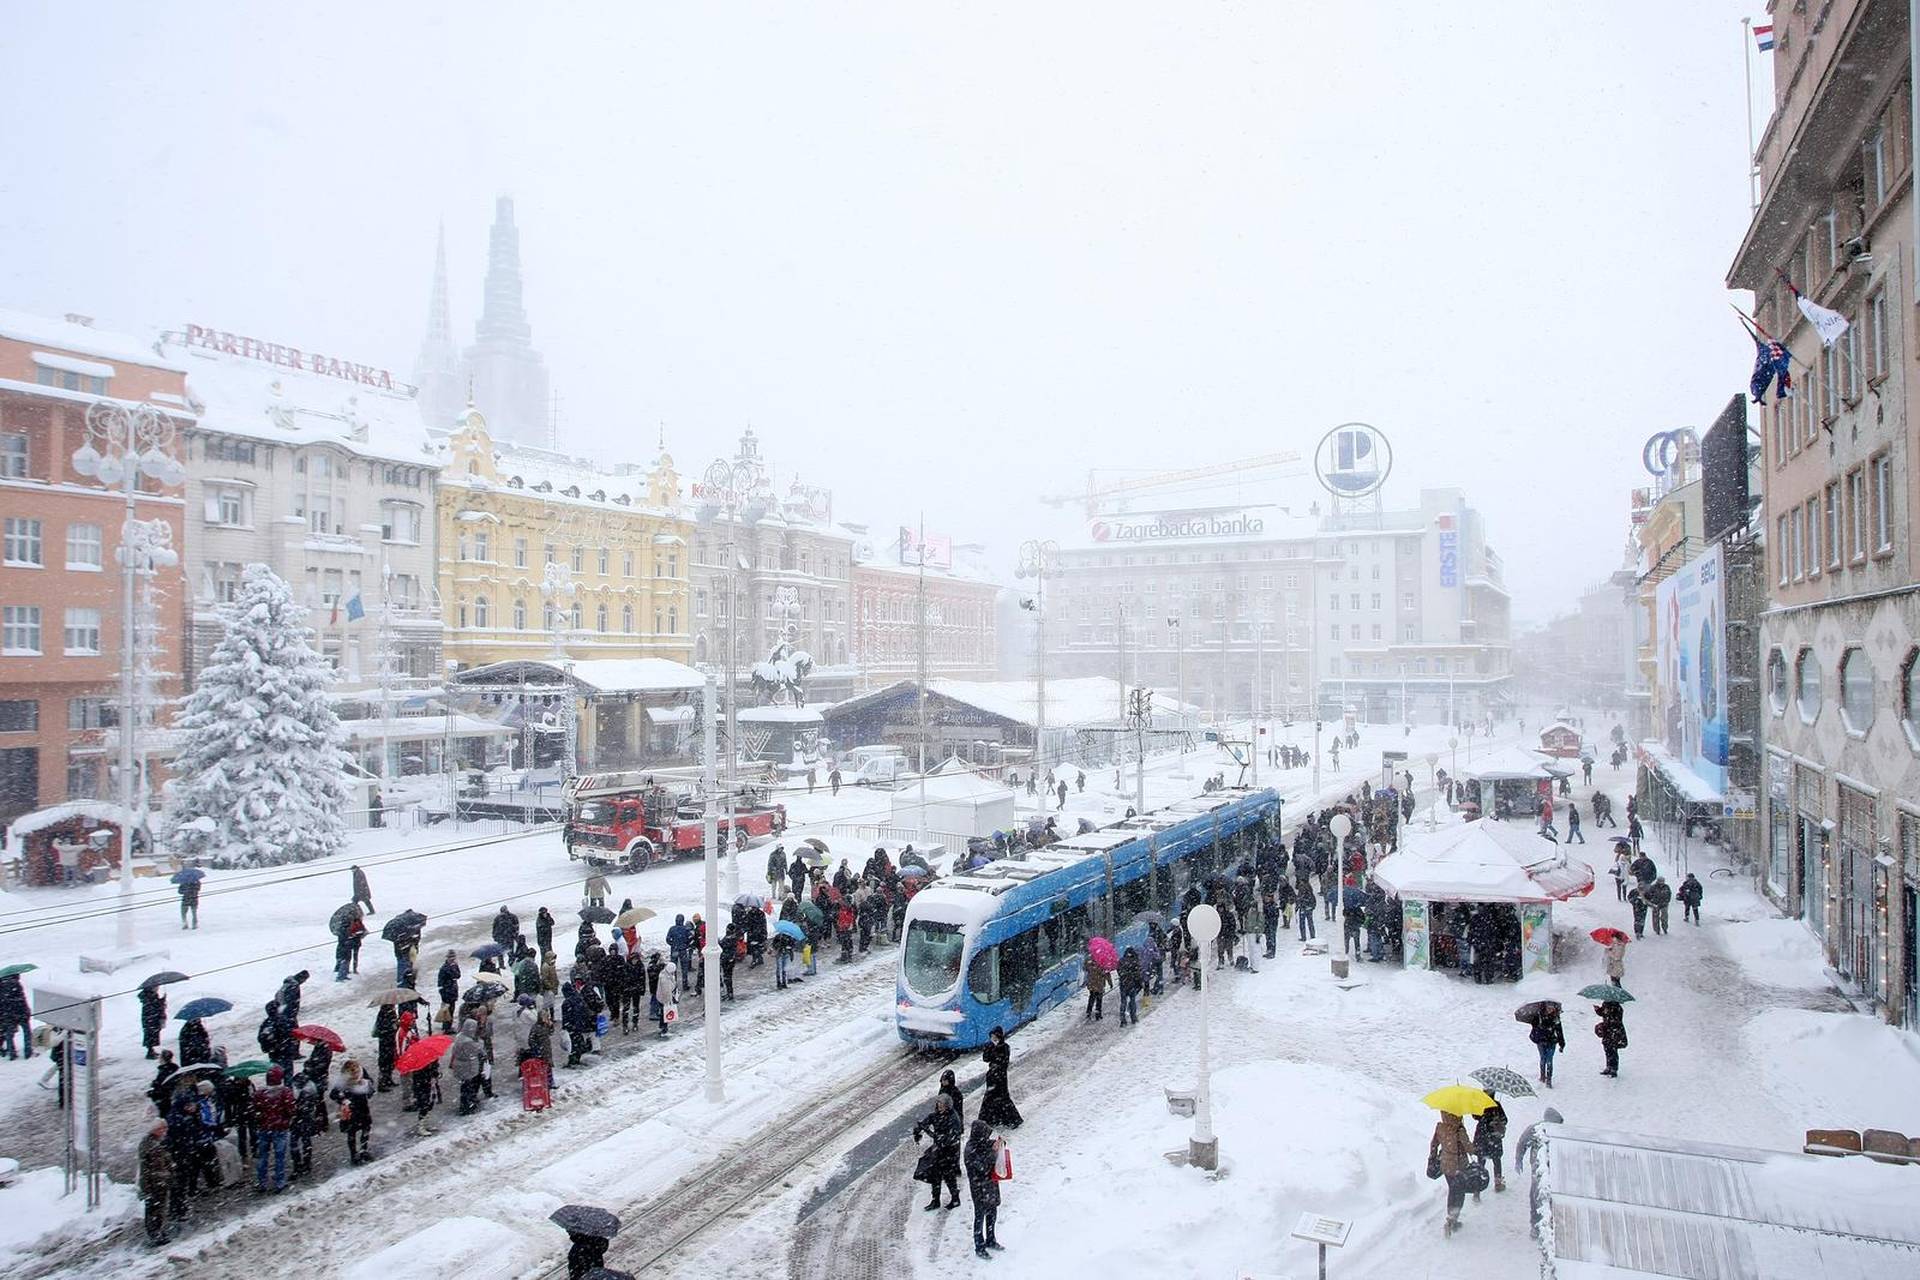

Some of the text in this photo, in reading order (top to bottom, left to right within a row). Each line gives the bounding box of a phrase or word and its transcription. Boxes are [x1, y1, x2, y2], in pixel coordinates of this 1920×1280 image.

[186, 324, 393, 391] PARTNER BANKA
[1211, 514, 1264, 534] banka
[1440, 532, 1457, 588] ERSTE
